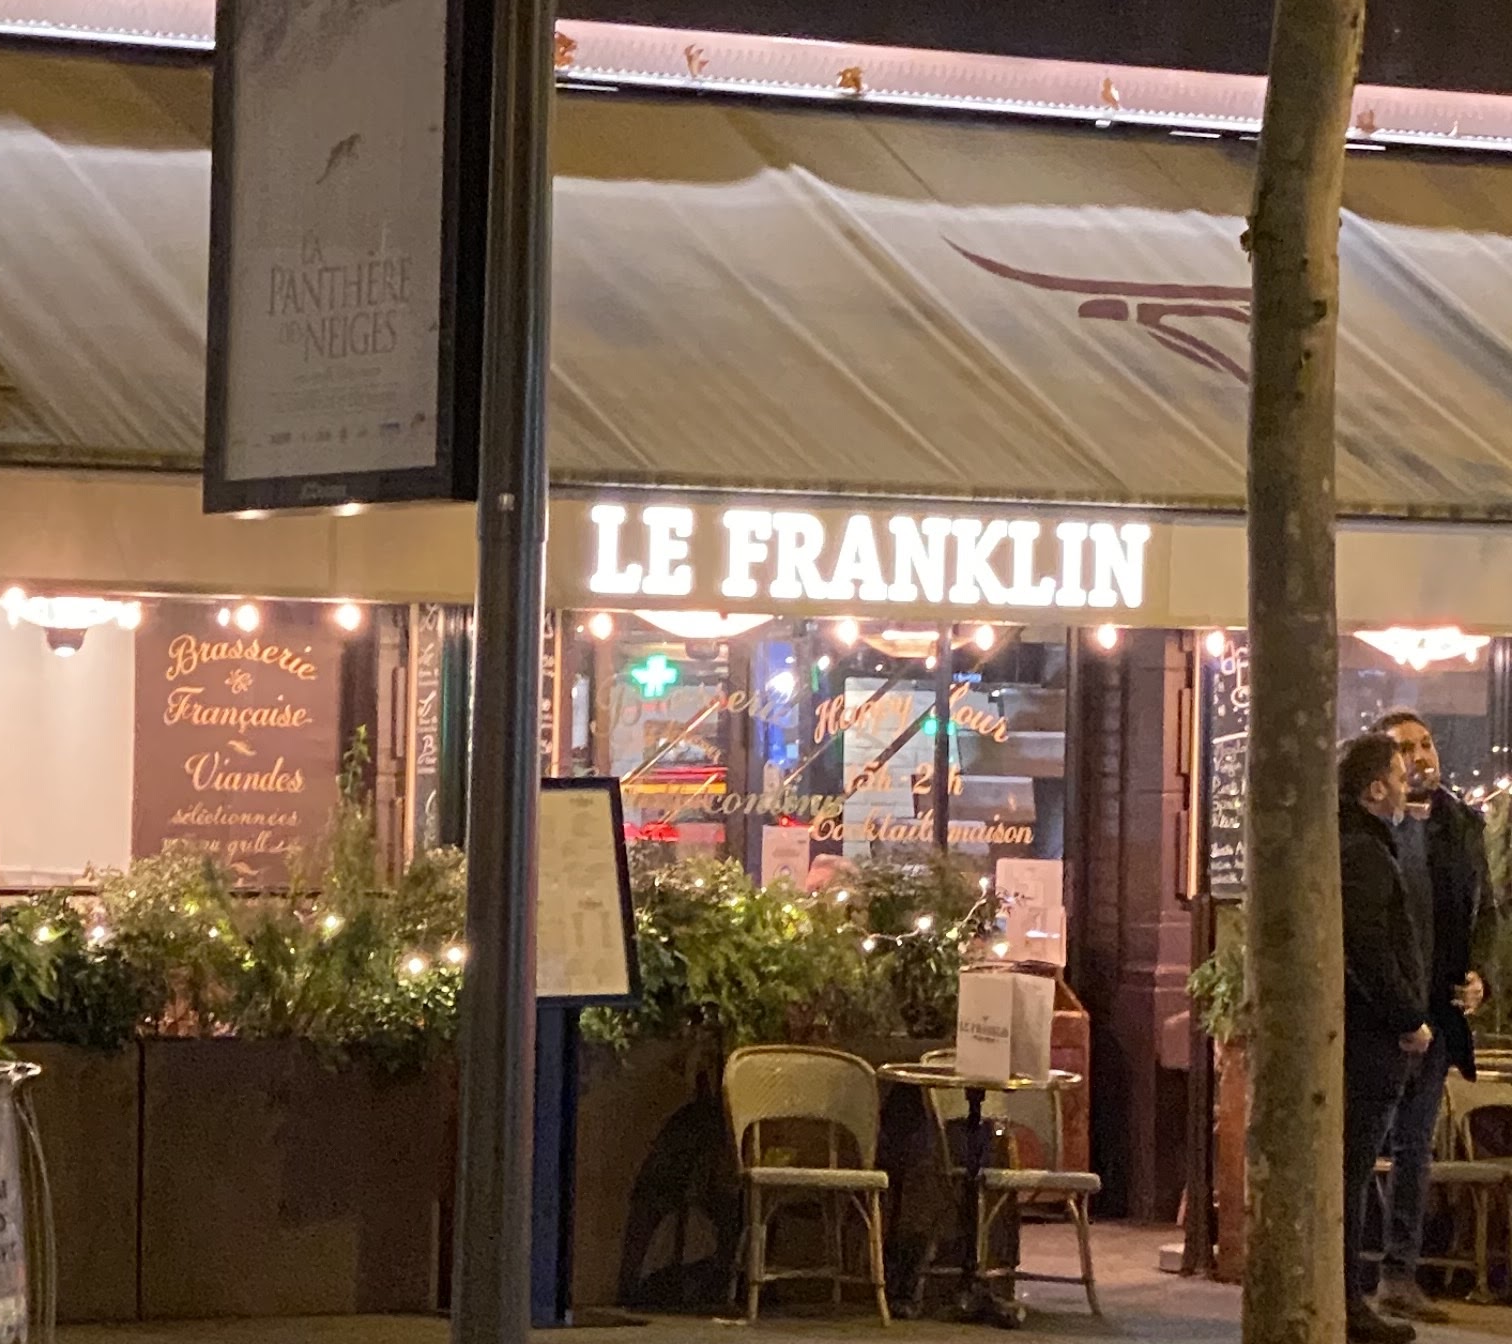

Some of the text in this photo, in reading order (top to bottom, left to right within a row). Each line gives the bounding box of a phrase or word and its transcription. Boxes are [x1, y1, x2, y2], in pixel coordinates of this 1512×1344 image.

[304, 309, 398, 362] NEIGES
[589, 504, 1150, 609] LE FRANKLIN
[166, 633, 319, 681] Brasserie
[163, 686, 313, 734] Française
[184, 751, 306, 794] Viandes
[912, 762, 964, 796] 2h
[947, 814, 1034, 845] maison
